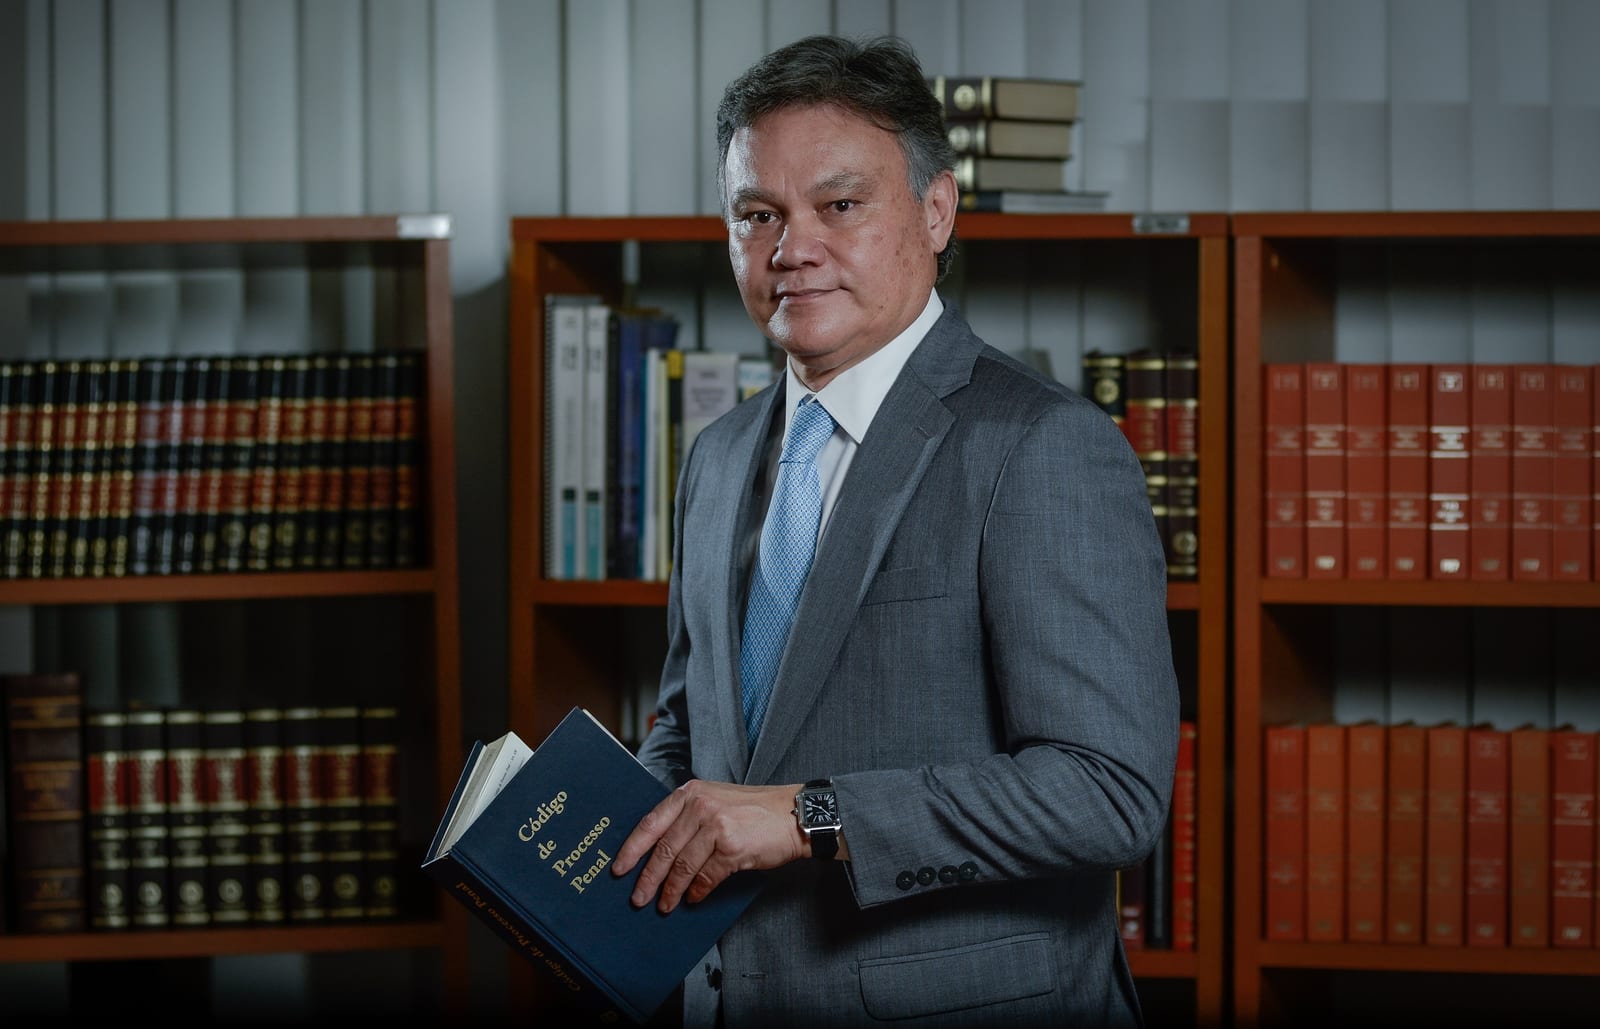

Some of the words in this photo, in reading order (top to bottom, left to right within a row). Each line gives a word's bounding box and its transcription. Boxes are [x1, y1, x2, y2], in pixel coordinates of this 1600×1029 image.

[519, 791, 567, 841] Código
[538, 840, 556, 859] de
[552, 817, 610, 877] Processo
[570, 849, 611, 894] Penal
[456, 881, 486, 908] Penal
[488, 908, 530, 946] Processo
